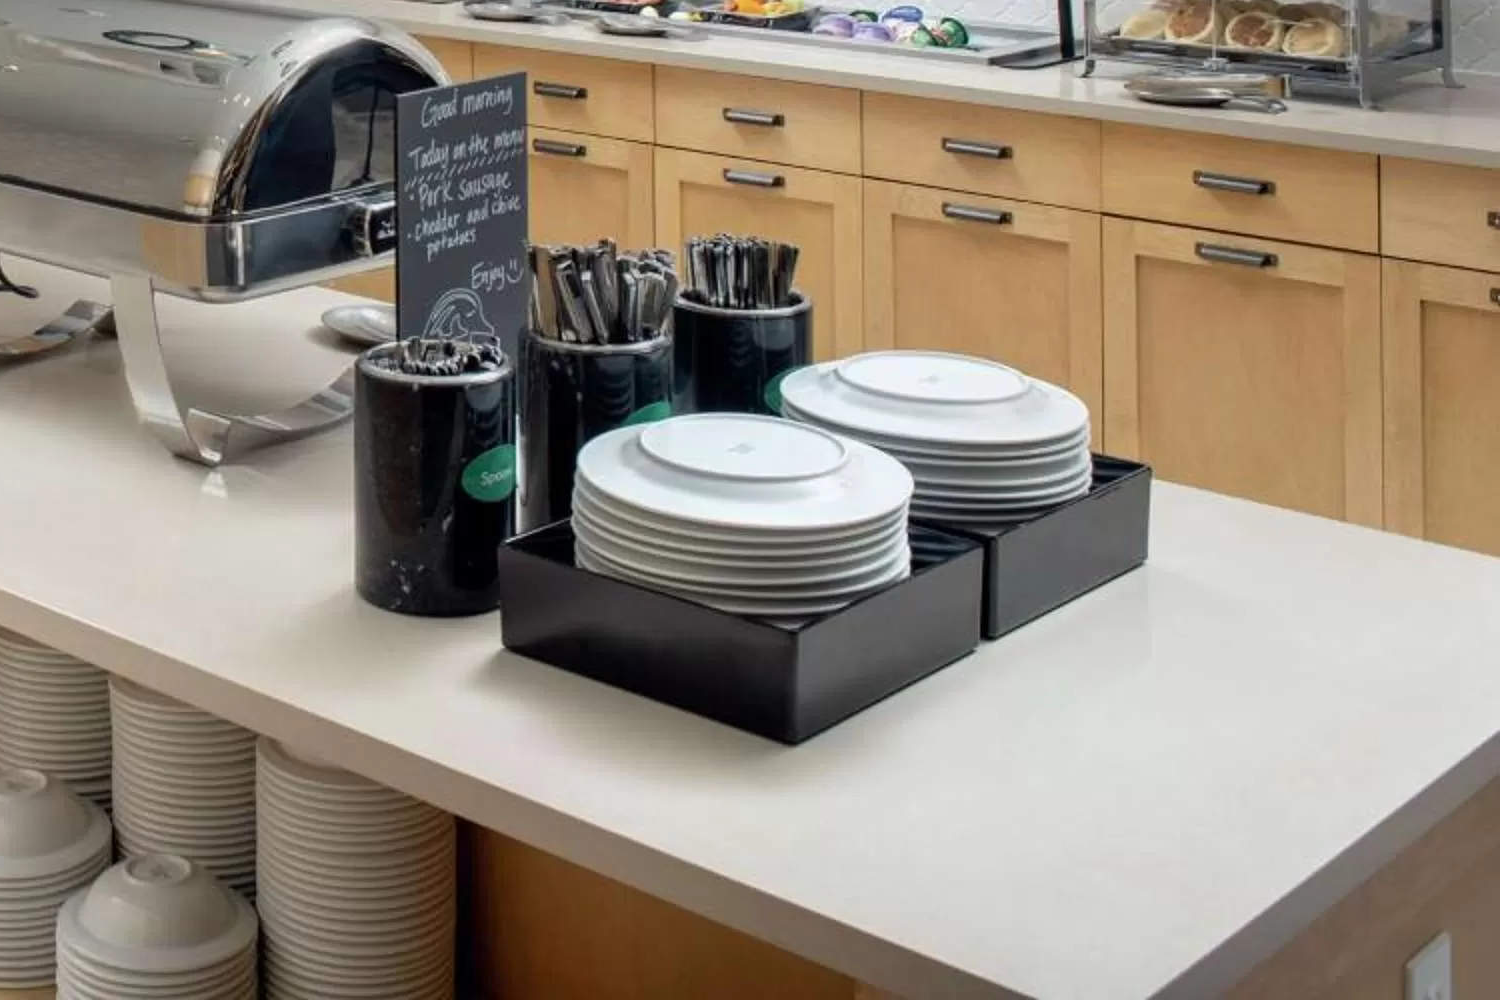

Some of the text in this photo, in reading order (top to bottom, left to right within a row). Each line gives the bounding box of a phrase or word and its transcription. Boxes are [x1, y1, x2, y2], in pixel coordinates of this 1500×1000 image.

[421, 85, 513, 128] Good morning
[408, 128, 525, 171] Today on the menu
[466, 198, 490, 225] and
[491, 195, 521, 216] chive
[427, 229, 476, 263] potatoes
[471, 262, 505, 292] Enjoy
